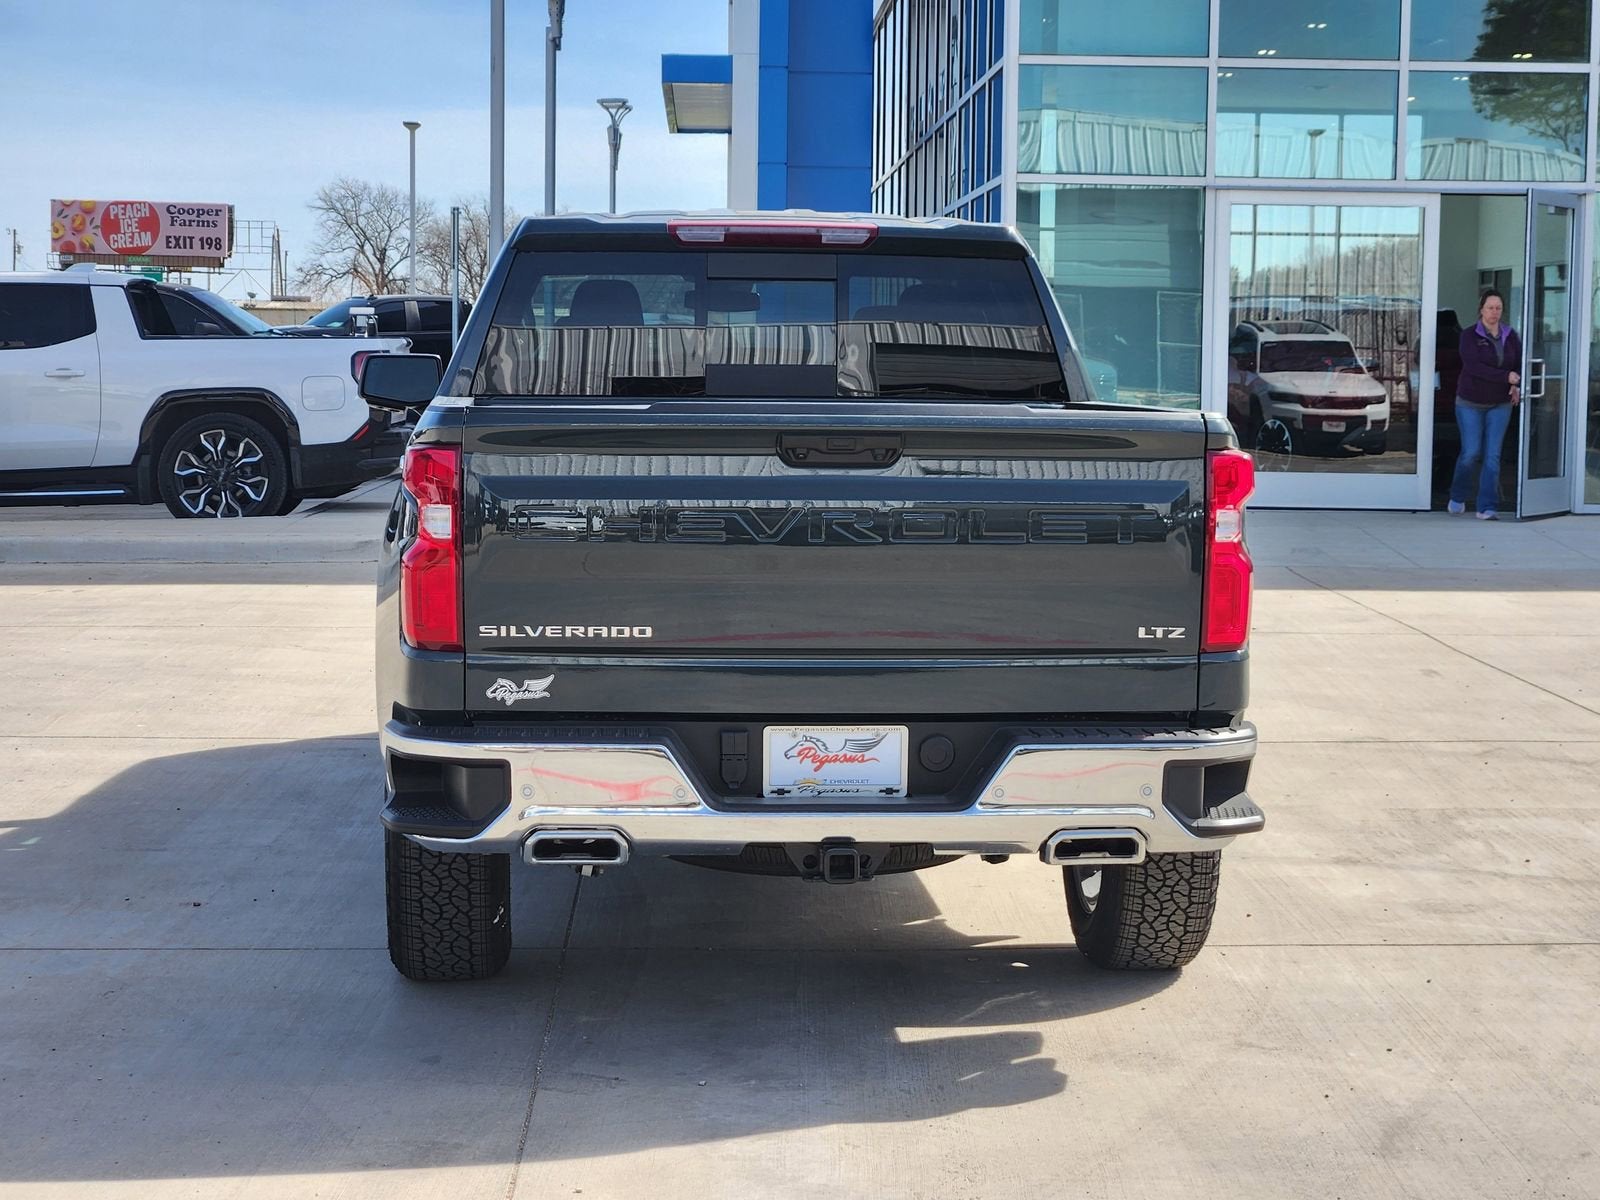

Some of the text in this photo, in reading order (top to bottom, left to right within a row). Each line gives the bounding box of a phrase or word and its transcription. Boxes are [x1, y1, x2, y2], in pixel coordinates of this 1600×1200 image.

[109, 203, 150, 219] PEACH
[166, 204, 222, 217] Cooper
[119, 218, 139, 233] ICE
[169, 215, 218, 229] Farms
[109, 233, 152, 249] CREAM
[165, 235, 222, 251] EXIT 198
[512, 505, 1159, 543] CHEVROLET
[479, 625, 652, 638] SILVERADO
[1138, 626, 1186, 638] LTZ
[496, 687, 550, 706] Pegasus
[797, 746, 880, 772] Pegasus
